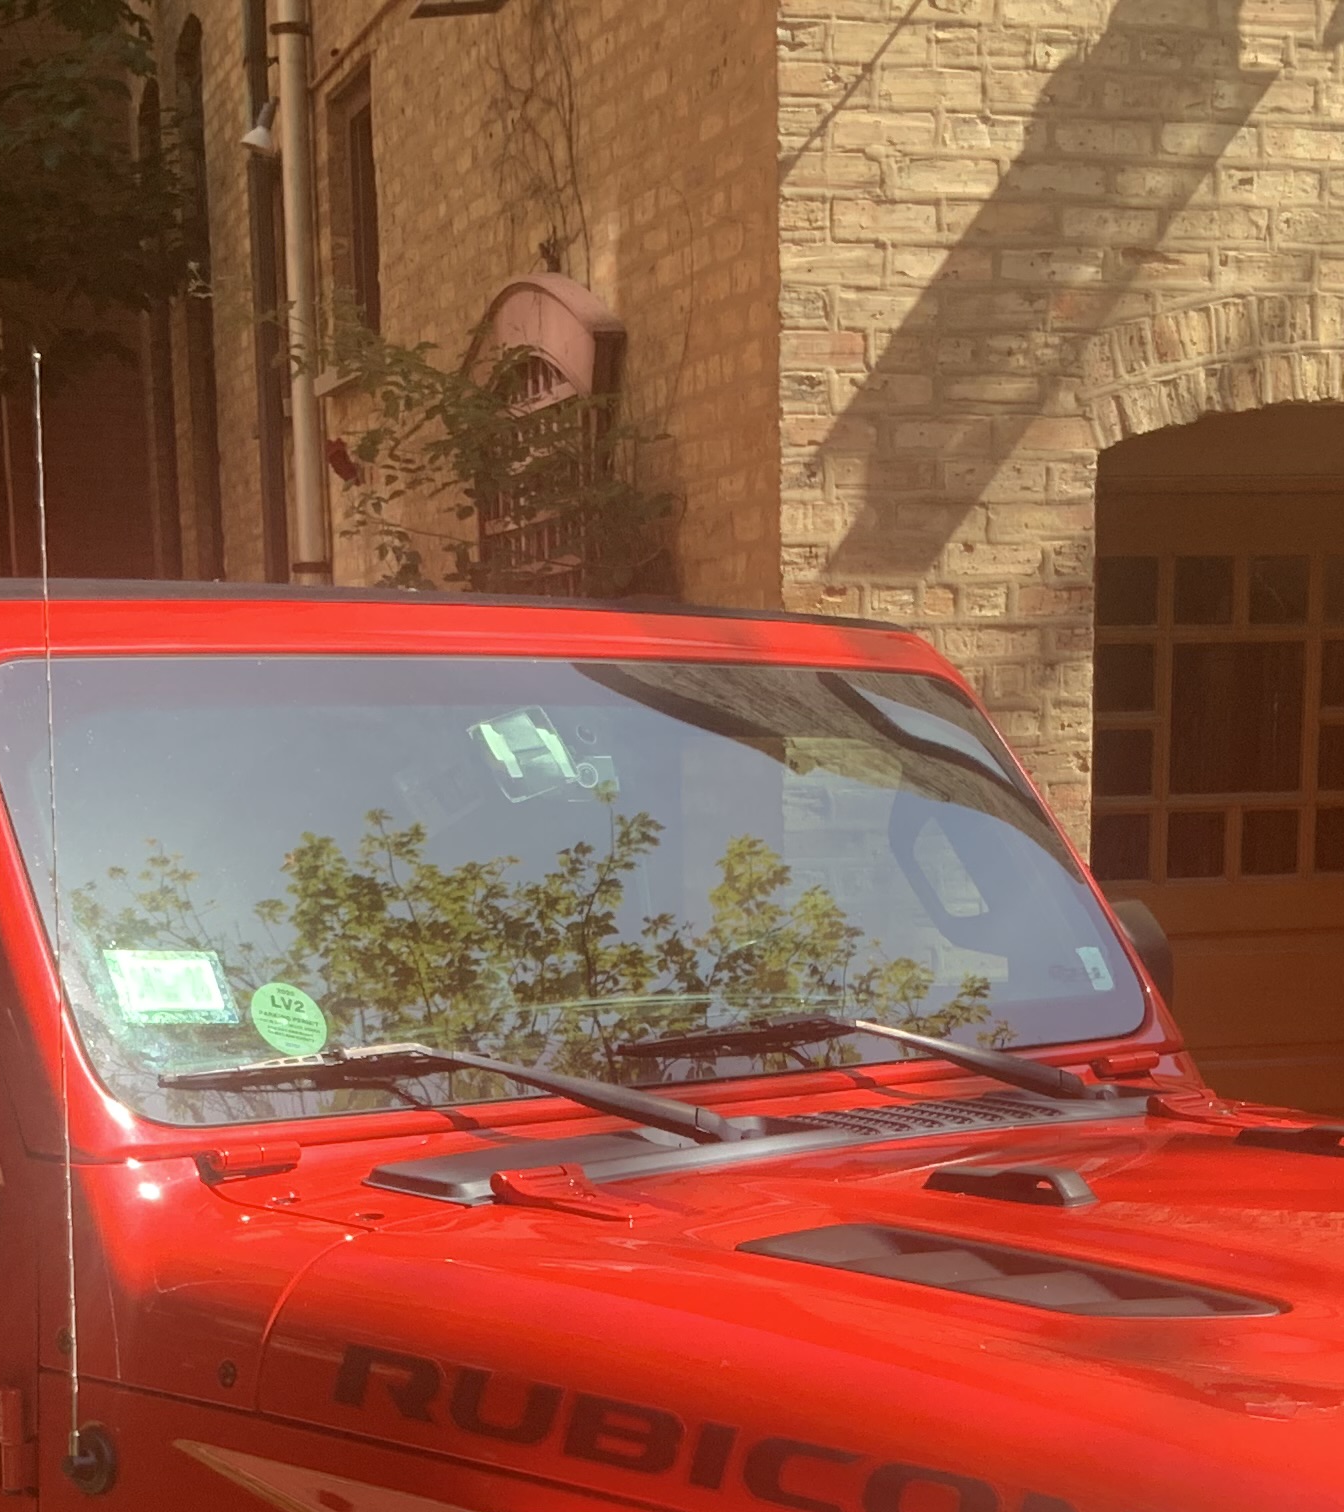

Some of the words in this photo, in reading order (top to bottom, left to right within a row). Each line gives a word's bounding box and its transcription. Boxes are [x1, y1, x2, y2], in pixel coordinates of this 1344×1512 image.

[270, 994, 306, 1013] LV2
[258, 1010, 291, 1021] PARKING
[292, 1017, 319, 1027] PERMIT
